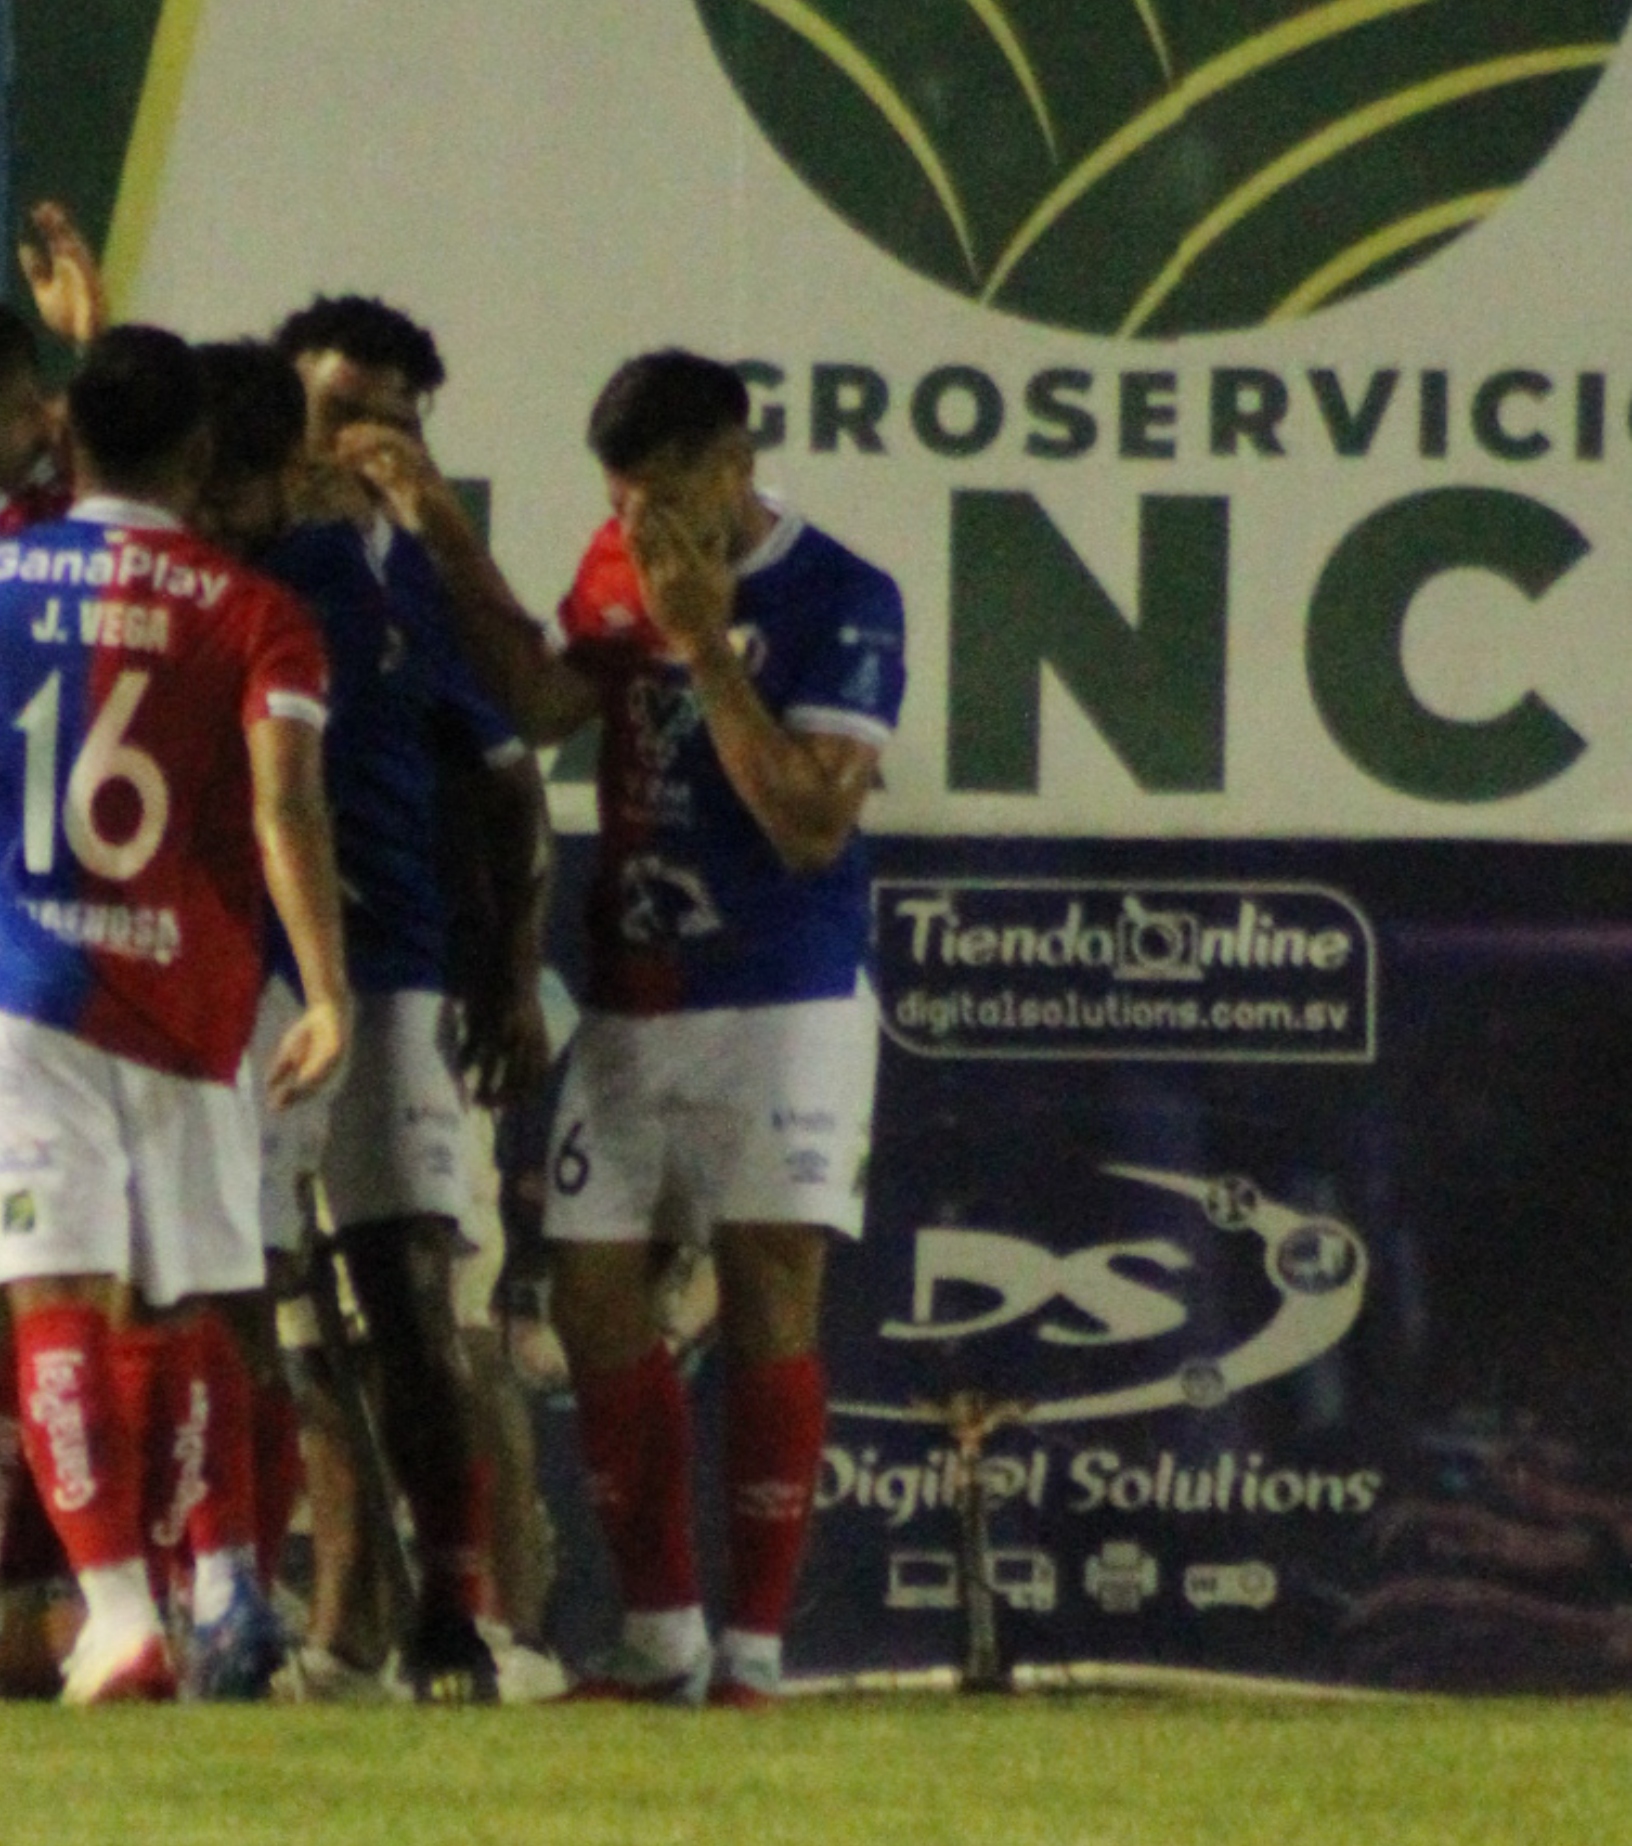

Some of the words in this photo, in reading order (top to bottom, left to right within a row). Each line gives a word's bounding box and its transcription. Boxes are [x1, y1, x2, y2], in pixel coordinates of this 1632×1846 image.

[723, 361, 1632, 460] GROSERVICI
[30, 598, 68, 645] J.
[78, 600, 173, 652] VEGA
[868, 485, 1592, 806] NC
[13, 668, 171, 881] 16
[895, 990, 1350, 1034] digitalsolutions.com.sv
[555, 1119, 591, 1195] 6
[878, 1227, 1196, 1347] DS
[1070, 1449, 1382, 1515] Solutions
